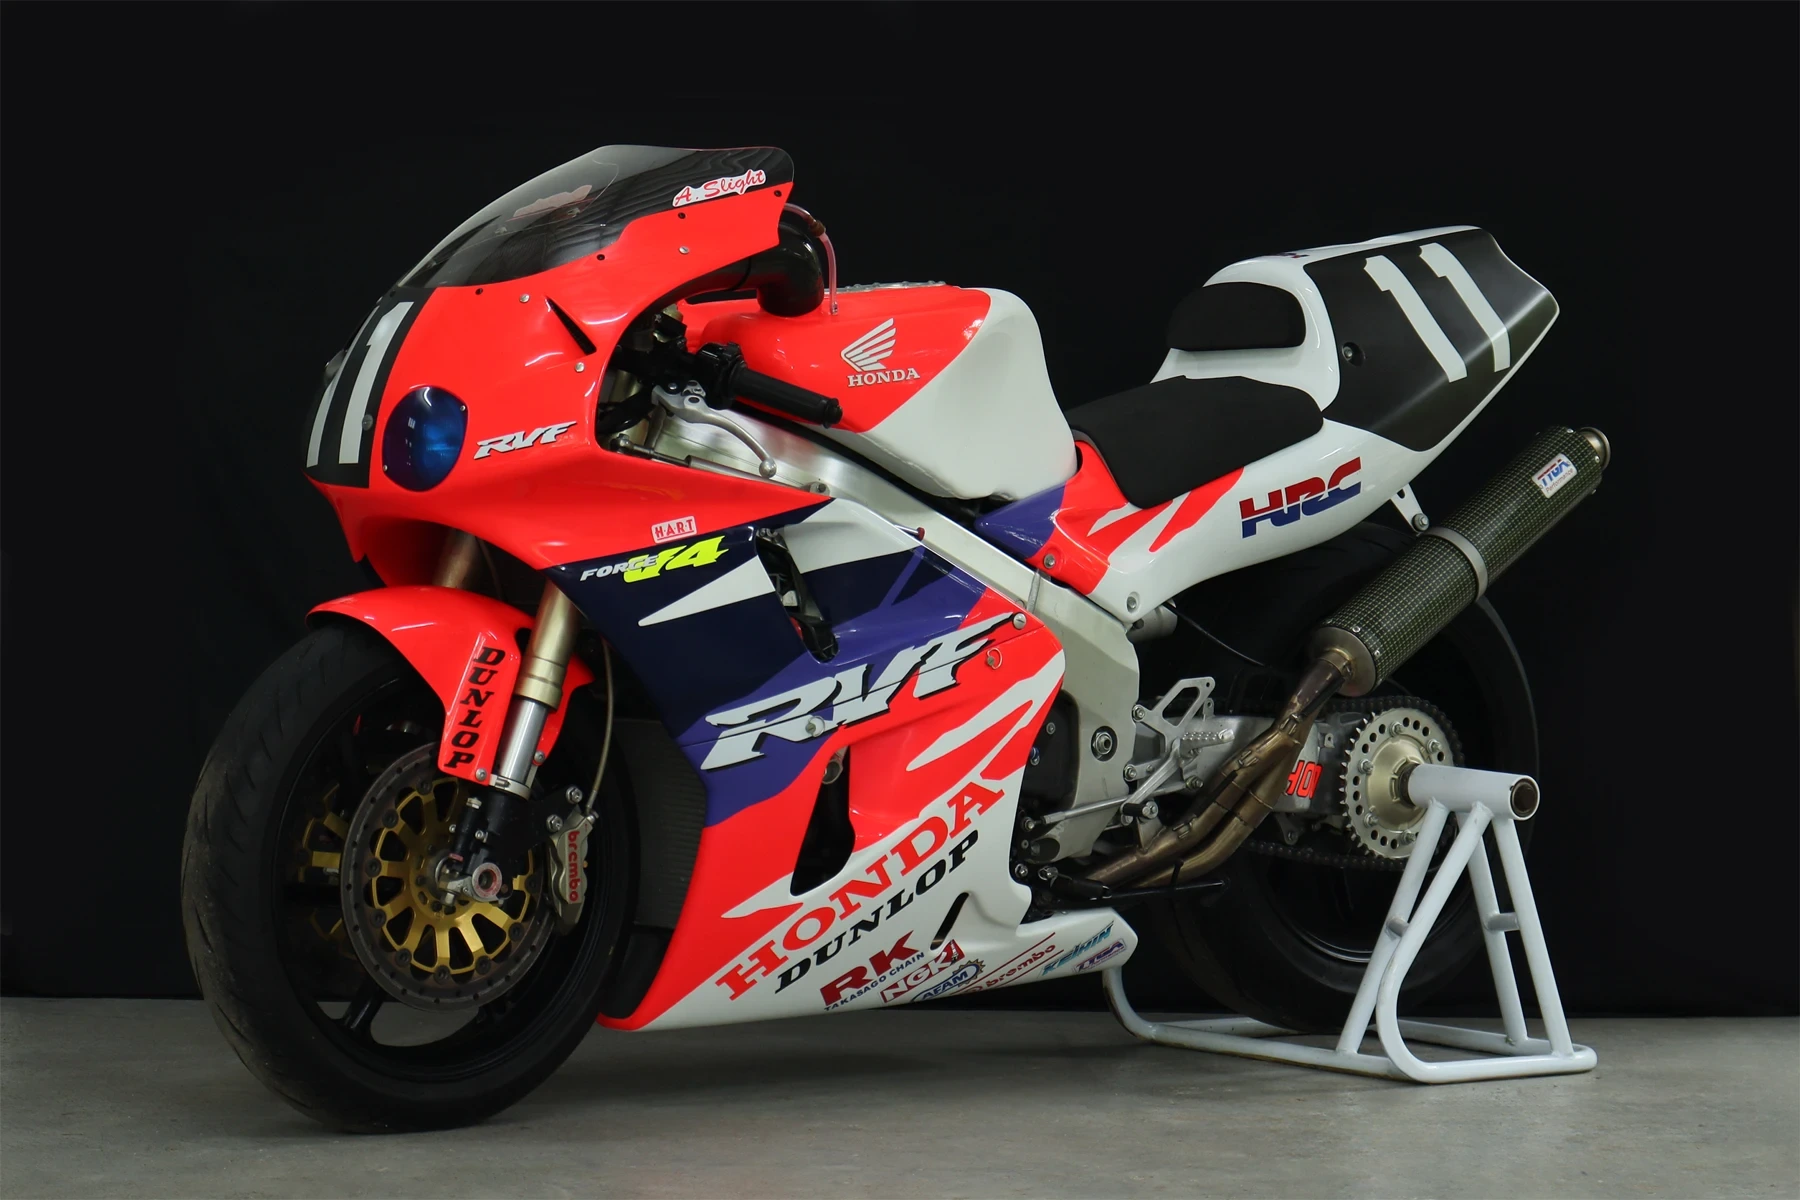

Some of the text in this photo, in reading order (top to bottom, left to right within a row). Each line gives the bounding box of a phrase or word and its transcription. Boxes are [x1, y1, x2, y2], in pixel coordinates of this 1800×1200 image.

[703, 169, 765, 198] Slight
[1363, 242, 1511, 383] 11
[847, 367, 920, 388] HONDA
[473, 420, 577, 460] RVF
[1239, 456, 1361, 539] HRC
[579, 554, 660, 581] FORCE
[444, 646, 506, 769] DUNLOP
[700, 612, 1019, 772] RVF
[567, 830, 582, 902] brembo
[715, 781, 1006, 1001] HONDA
[774, 829, 980, 994] DUNLOP
[819, 929, 920, 1007] RK
[881, 950, 951, 1003] NGK
[985, 944, 1056, 988] brembo
[1041, 920, 1114, 977] KEIHIN
[823, 951, 925, 1012] TAKASAGO CHAIN
[922, 970, 969, 1000] AFAM
